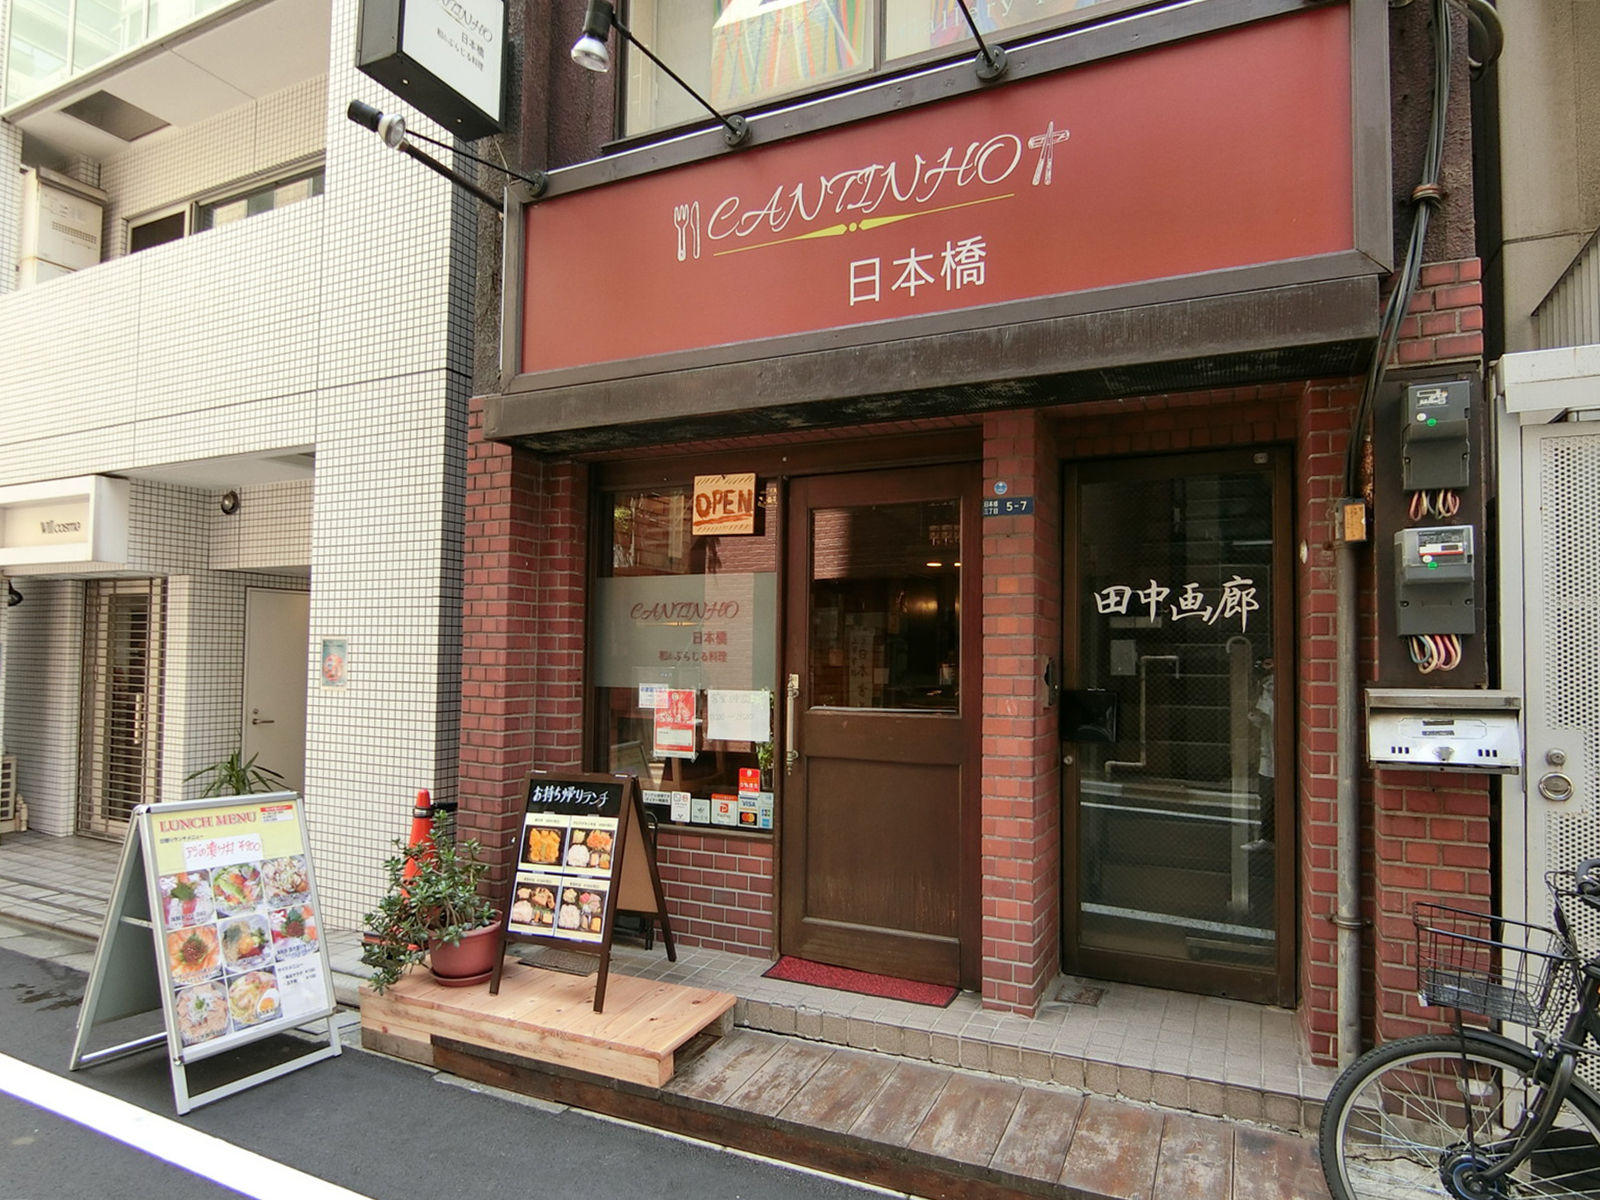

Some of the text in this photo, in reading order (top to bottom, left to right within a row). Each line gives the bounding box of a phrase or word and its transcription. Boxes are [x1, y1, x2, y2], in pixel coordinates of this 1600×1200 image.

[902, 0, 1015, 36] allery
[707, 134, 1022, 240] CANTINHO
[849, 235, 988, 306] 日本橋
[695, 489, 753, 518] OPEN
[1006, 501, 1027, 512] 5-7
[630, 601, 739, 621] CANTINHO
[1094, 575, 1260, 633] 田中画廊
[693, 631, 727, 645] 日本橋
[533, 785, 609, 808] お持ち帰りランチ
[742, 800, 756, 808] VISA
[159, 815, 213, 832] LUNCH
[215, 811, 258, 826] MENU
